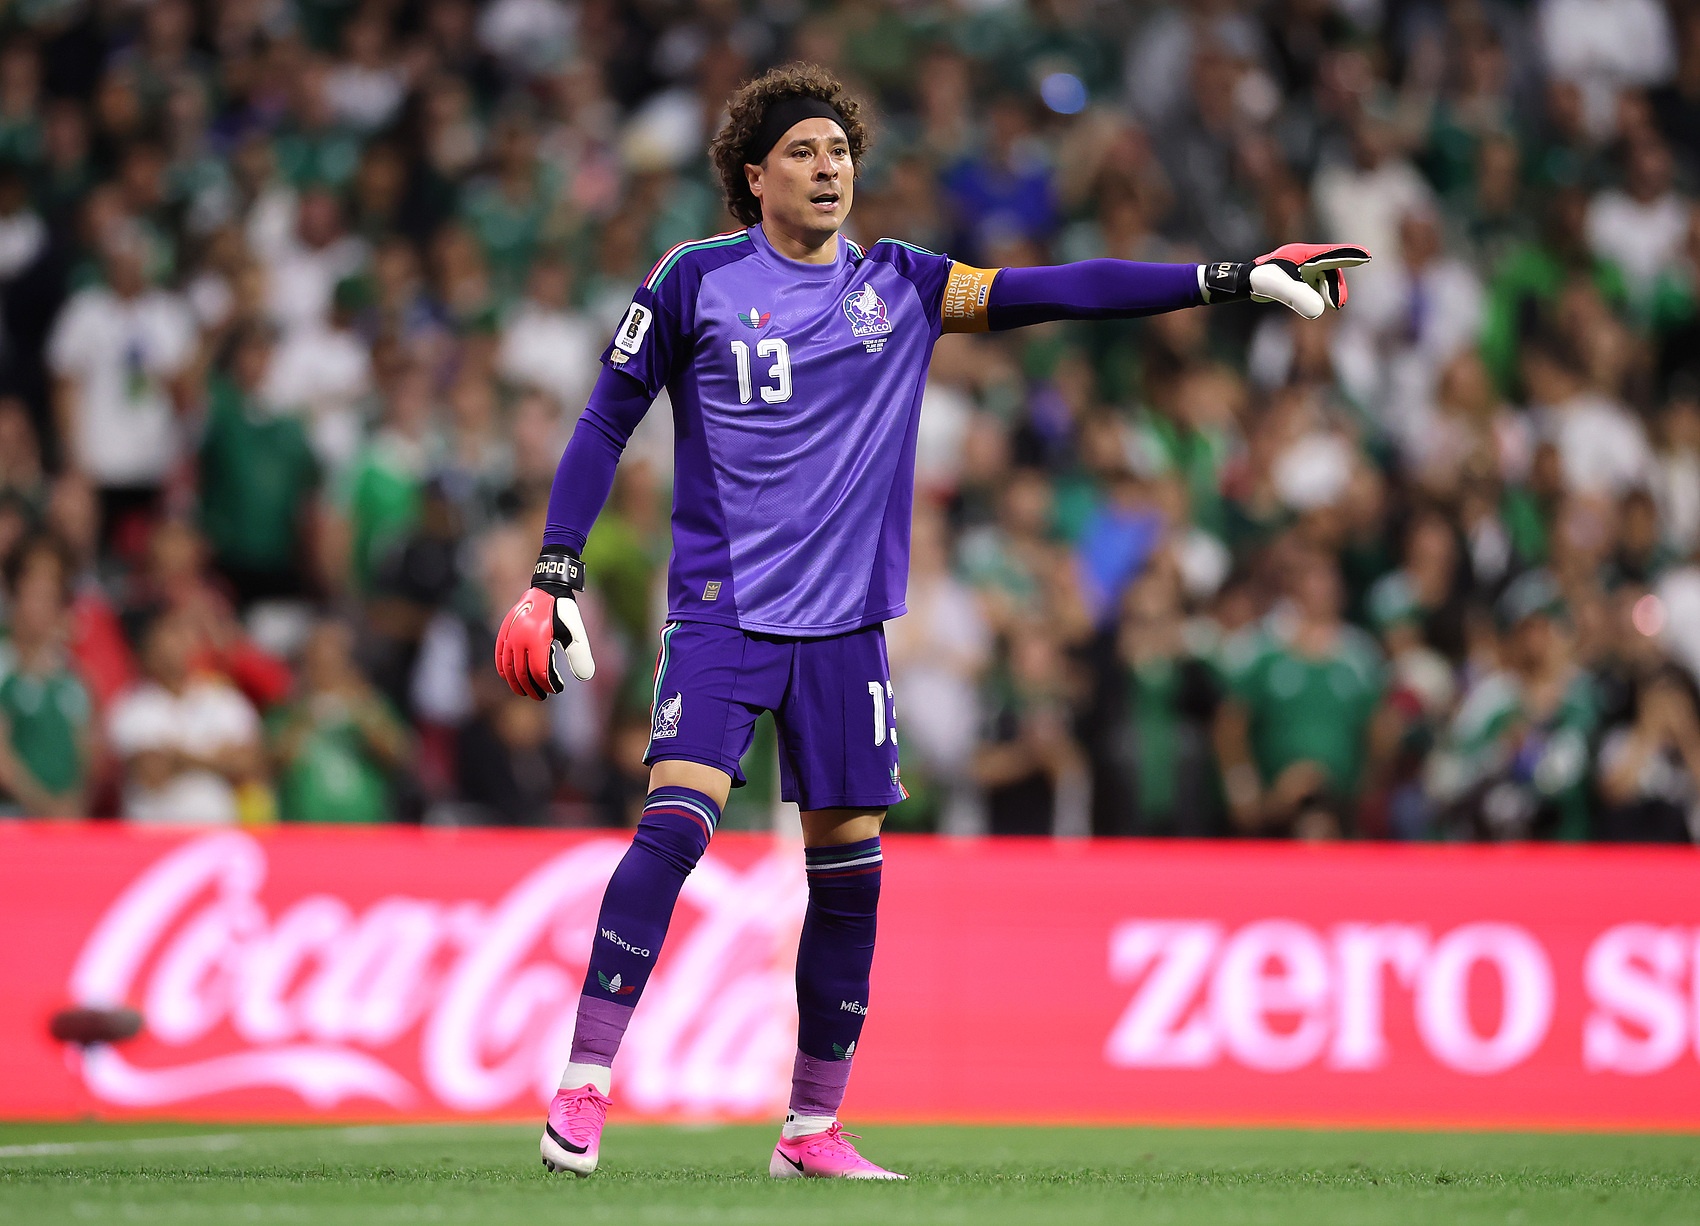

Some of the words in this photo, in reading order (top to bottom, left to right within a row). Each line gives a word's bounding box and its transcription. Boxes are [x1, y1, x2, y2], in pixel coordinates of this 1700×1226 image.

[945, 273, 961, 318] FOOTBALL
[954, 273, 973, 318] UNITES
[967, 272, 984, 301] World
[978, 286, 987, 305] FIFA
[965, 302, 975, 319] the
[854, 323, 889, 335] MÉXICO
[731, 338, 793, 405] 13
[601, 927, 651, 958] MÉXICO
[840, 1000, 868, 1016] MÉXI
[1106, 919, 1554, 1072] zero
[1583, 923, 1700, 1073] s
